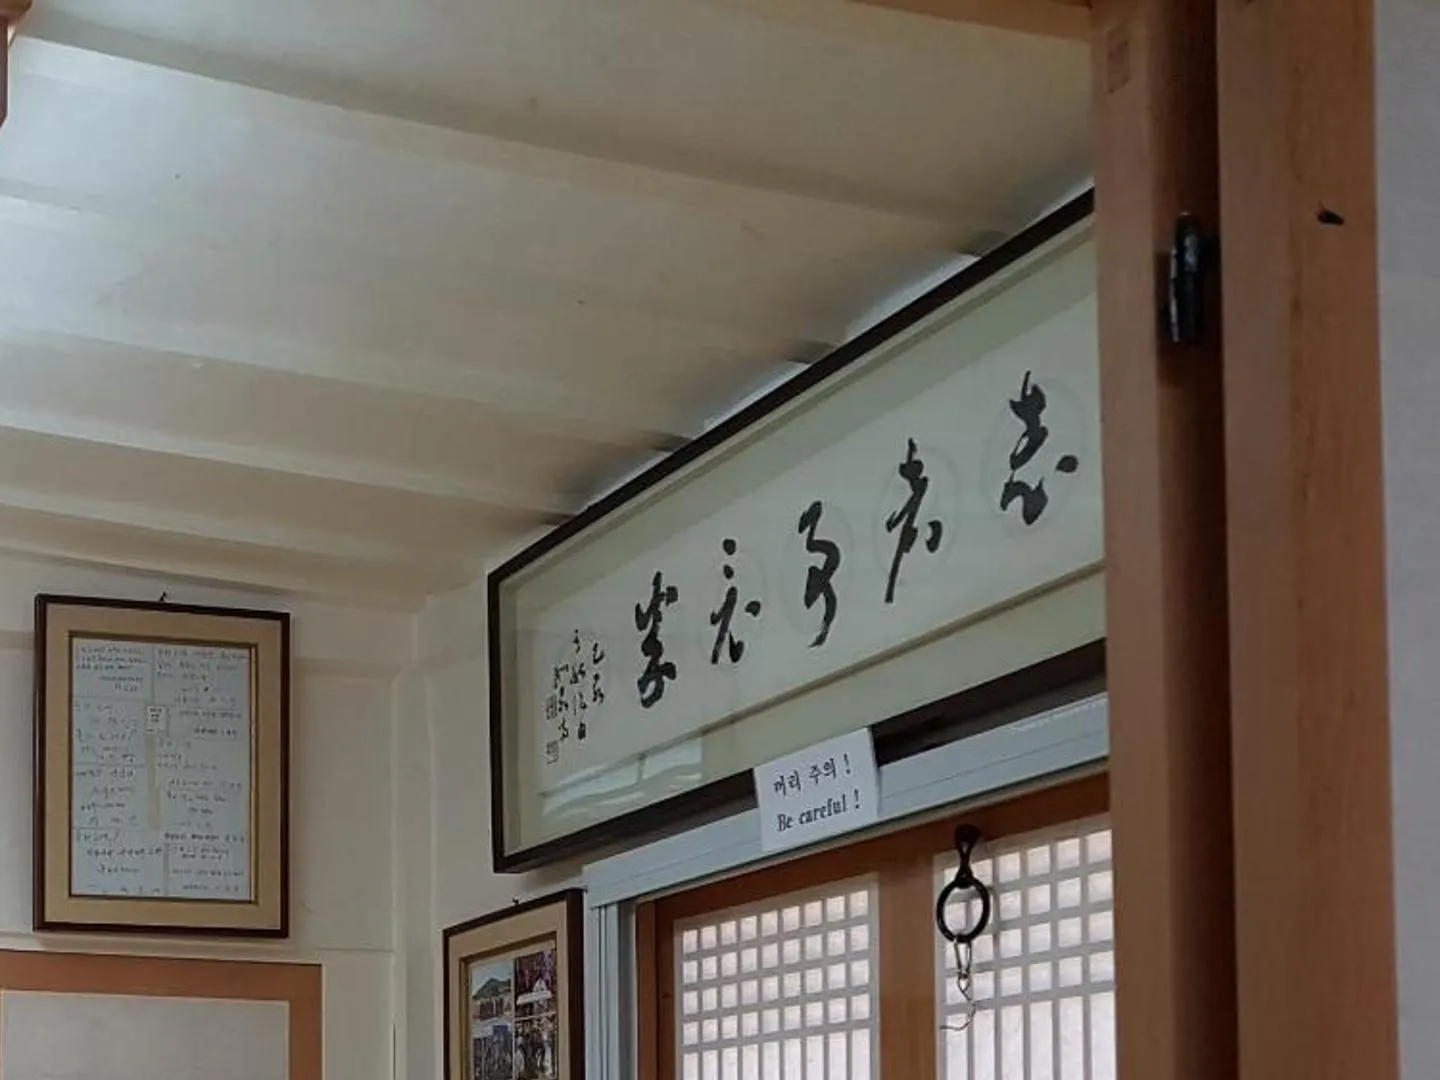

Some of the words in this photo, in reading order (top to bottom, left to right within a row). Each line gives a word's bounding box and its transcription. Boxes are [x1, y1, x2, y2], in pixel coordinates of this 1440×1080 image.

[773, 770, 801, 795] 머리
[809, 757, 837, 785] 주의
[776, 813, 794, 832] Be
[799, 794, 847, 825] careful
